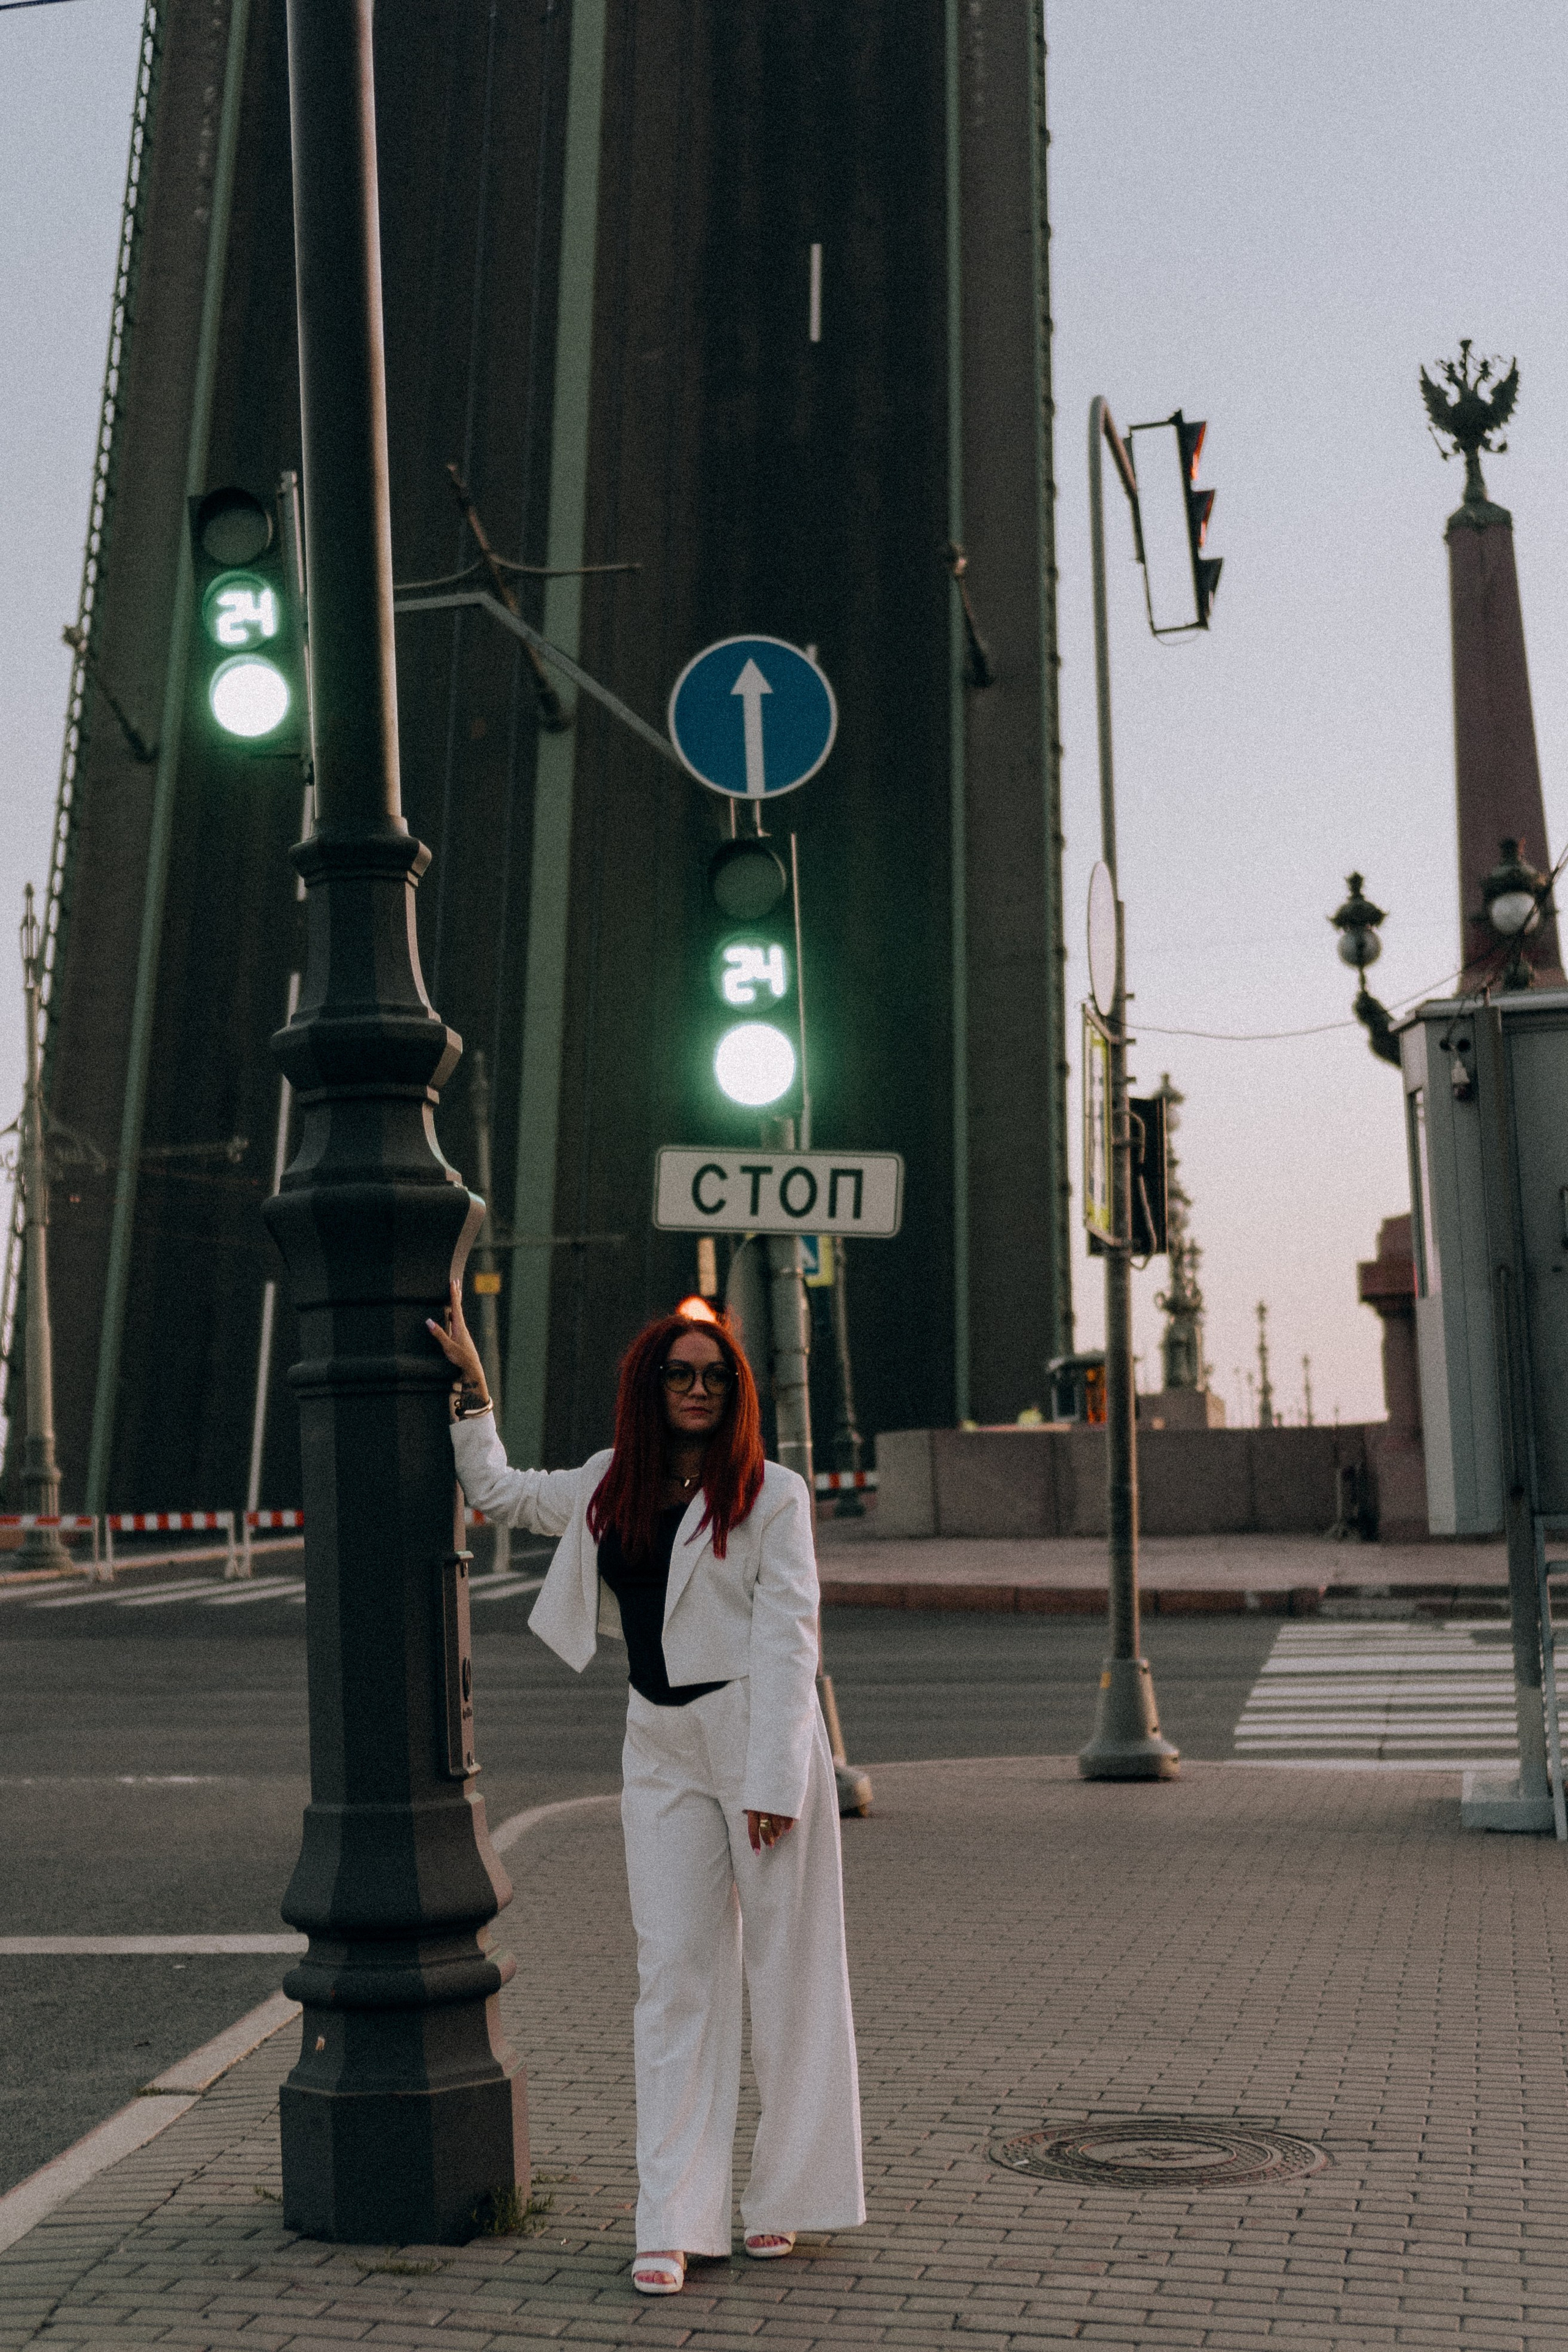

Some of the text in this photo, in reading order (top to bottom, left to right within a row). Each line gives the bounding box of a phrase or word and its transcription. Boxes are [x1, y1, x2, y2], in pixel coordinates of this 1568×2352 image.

[215, 586, 278, 645] 24
[721, 943, 787, 1006] 24
[691, 1163, 864, 1219] СТОП
